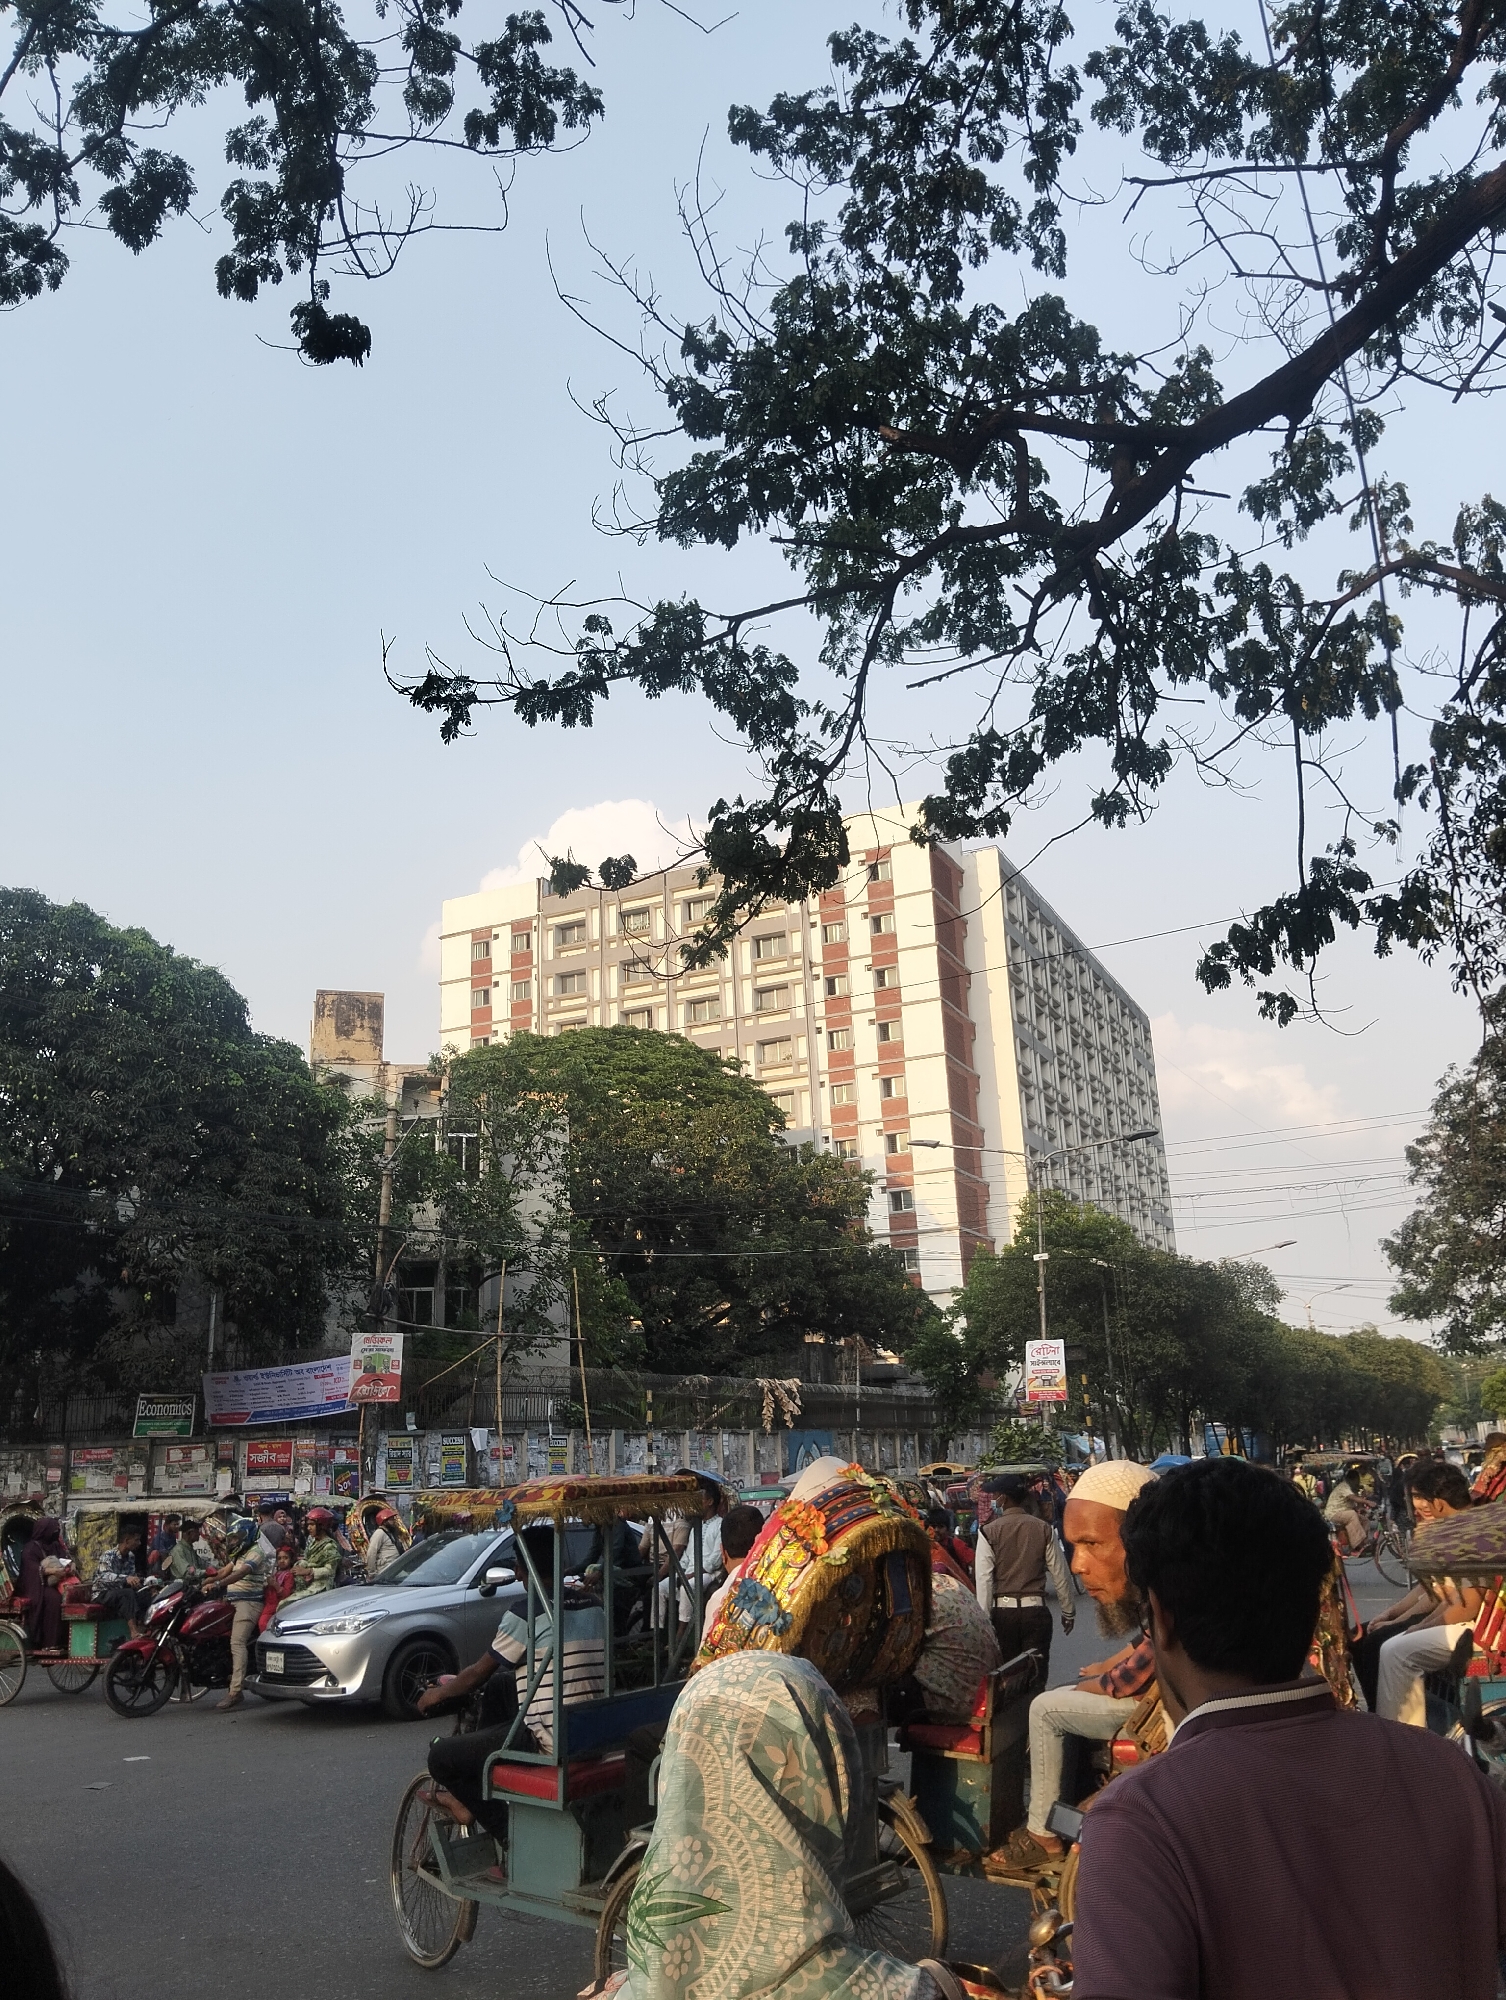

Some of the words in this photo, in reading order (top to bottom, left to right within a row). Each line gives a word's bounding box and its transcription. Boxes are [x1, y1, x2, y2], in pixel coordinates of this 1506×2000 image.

[1031, 1344, 1060, 1357] রেটিনা
[138, 1399, 192, 1416] Economics
[442, 1436, 464, 1445] SUCCESS
[249, 1450, 276, 1463] সজীব
